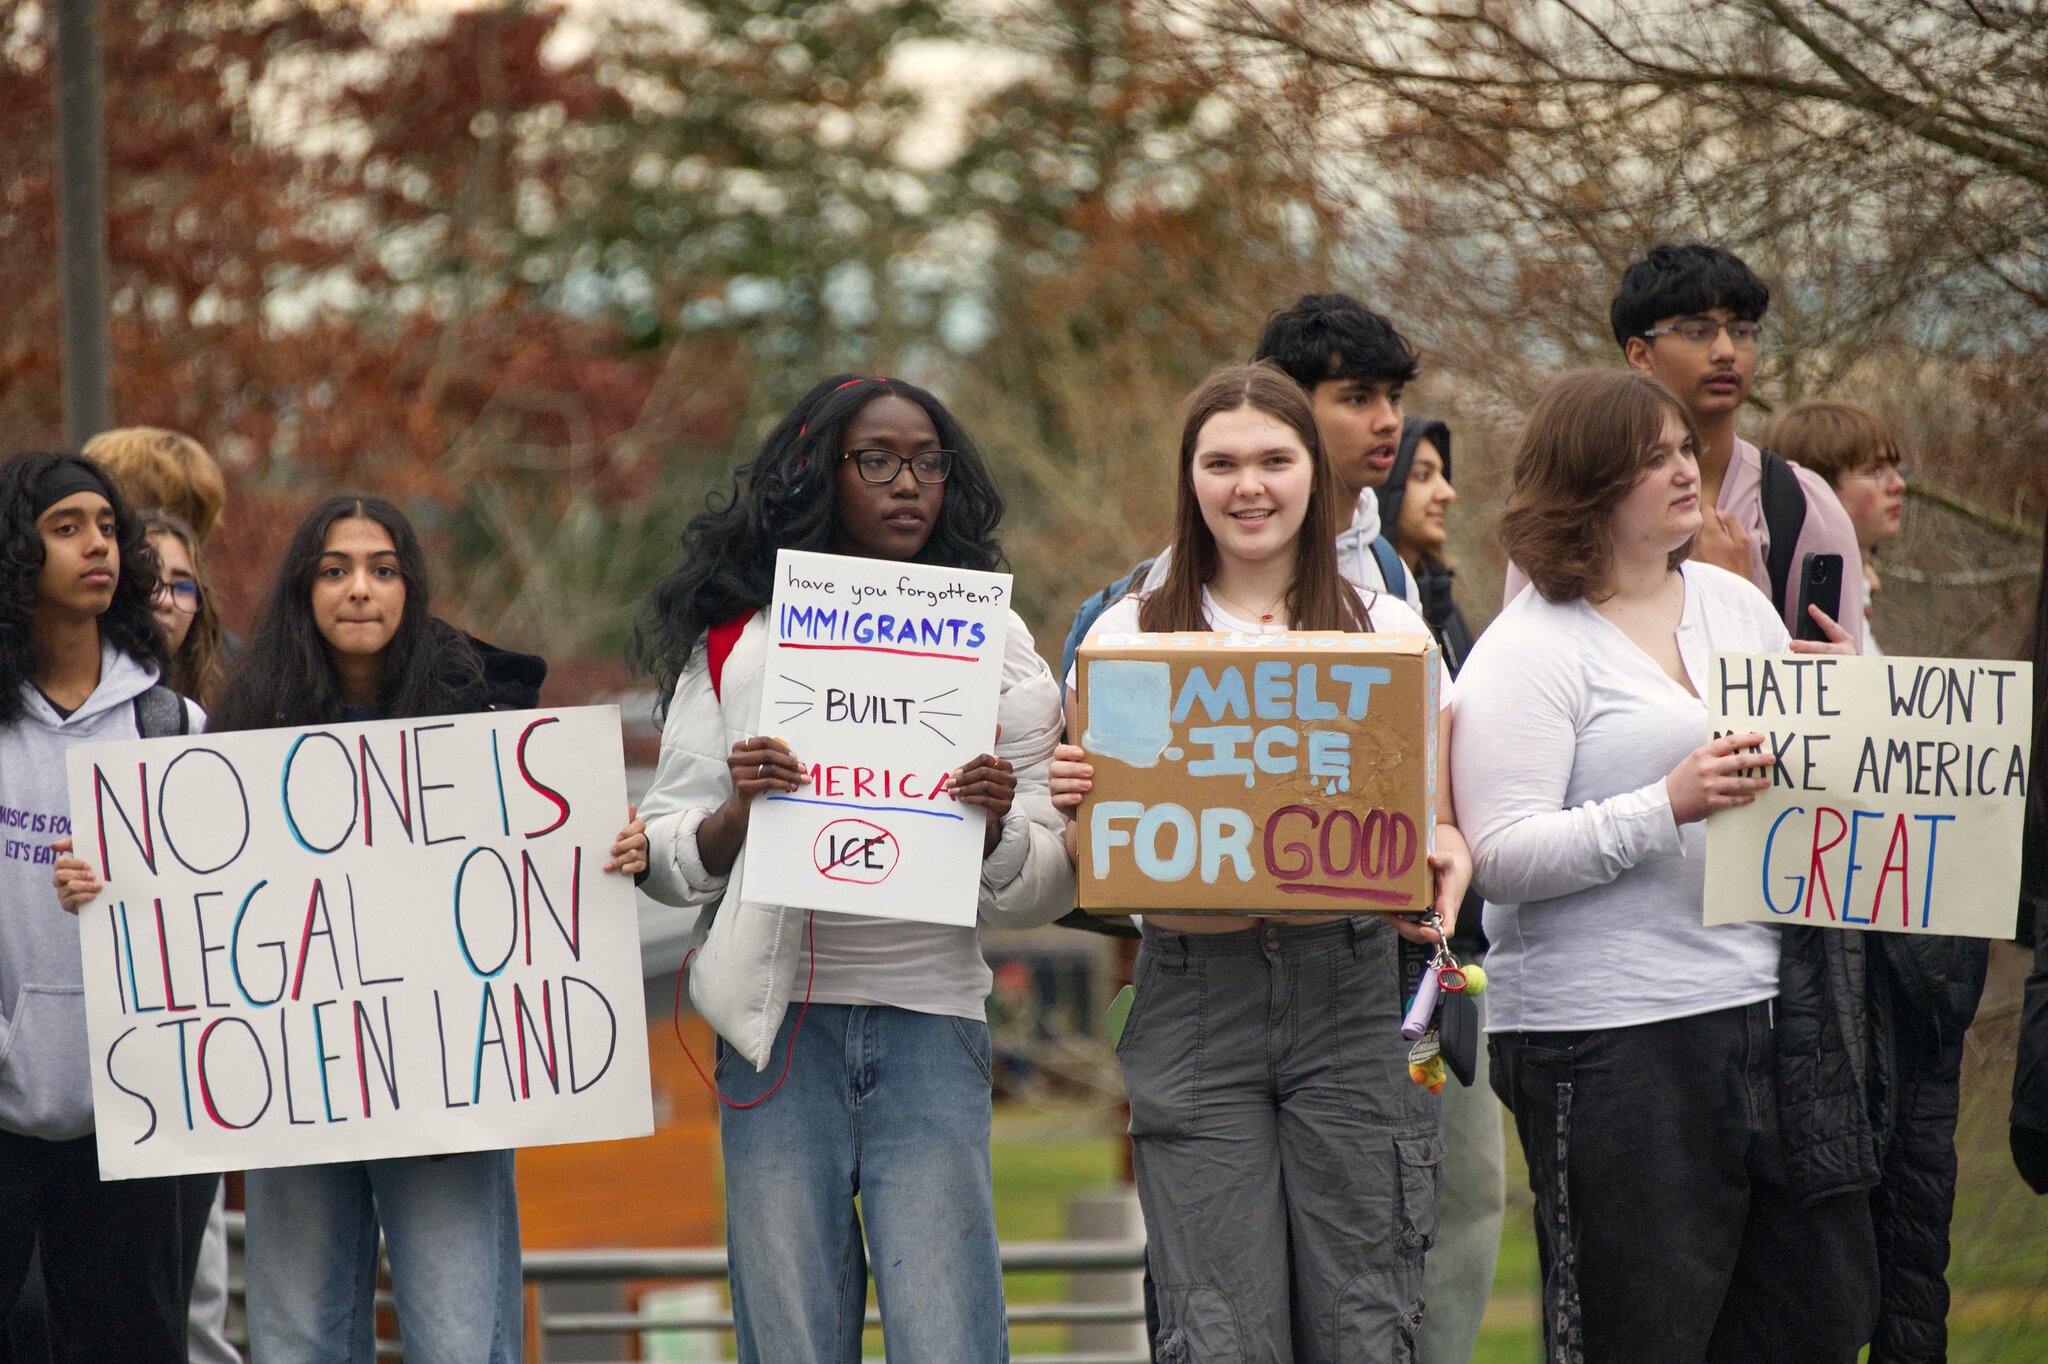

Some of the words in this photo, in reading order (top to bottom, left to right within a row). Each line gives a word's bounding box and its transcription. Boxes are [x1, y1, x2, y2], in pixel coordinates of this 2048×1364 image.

[788, 565, 835, 594] have
[852, 584, 888, 605] you
[897, 576, 1004, 607] forgotten?
[780, 602, 986, 648] IMMIGRANTS
[826, 688, 915, 725] BUILT
[1172, 661, 1391, 723] MELT
[1720, 657, 1841, 716] HATE
[1888, 664, 2017, 725] WON'T
[763, 763, 957, 802] MERICA
[1187, 725, 1351, 795] ICE
[1853, 736, 2026, 797] AMERICA
[31, 814, 47, 832] IS
[94, 748, 249, 881] NO
[282, 724, 466, 854] ONE
[492, 717, 570, 839] IS
[5, 839, 31, 861] LET'S
[829, 834, 886, 869] ICE
[1090, 801, 1256, 884] FOR
[1263, 804, 1417, 881] GOOD
[1762, 806, 1956, 928] GREAT
[109, 873, 404, 1015] ILLEGAL
[454, 846, 581, 977] ON
[107, 996, 400, 1145] STOLEN
[434, 976, 616, 1108] LAND
